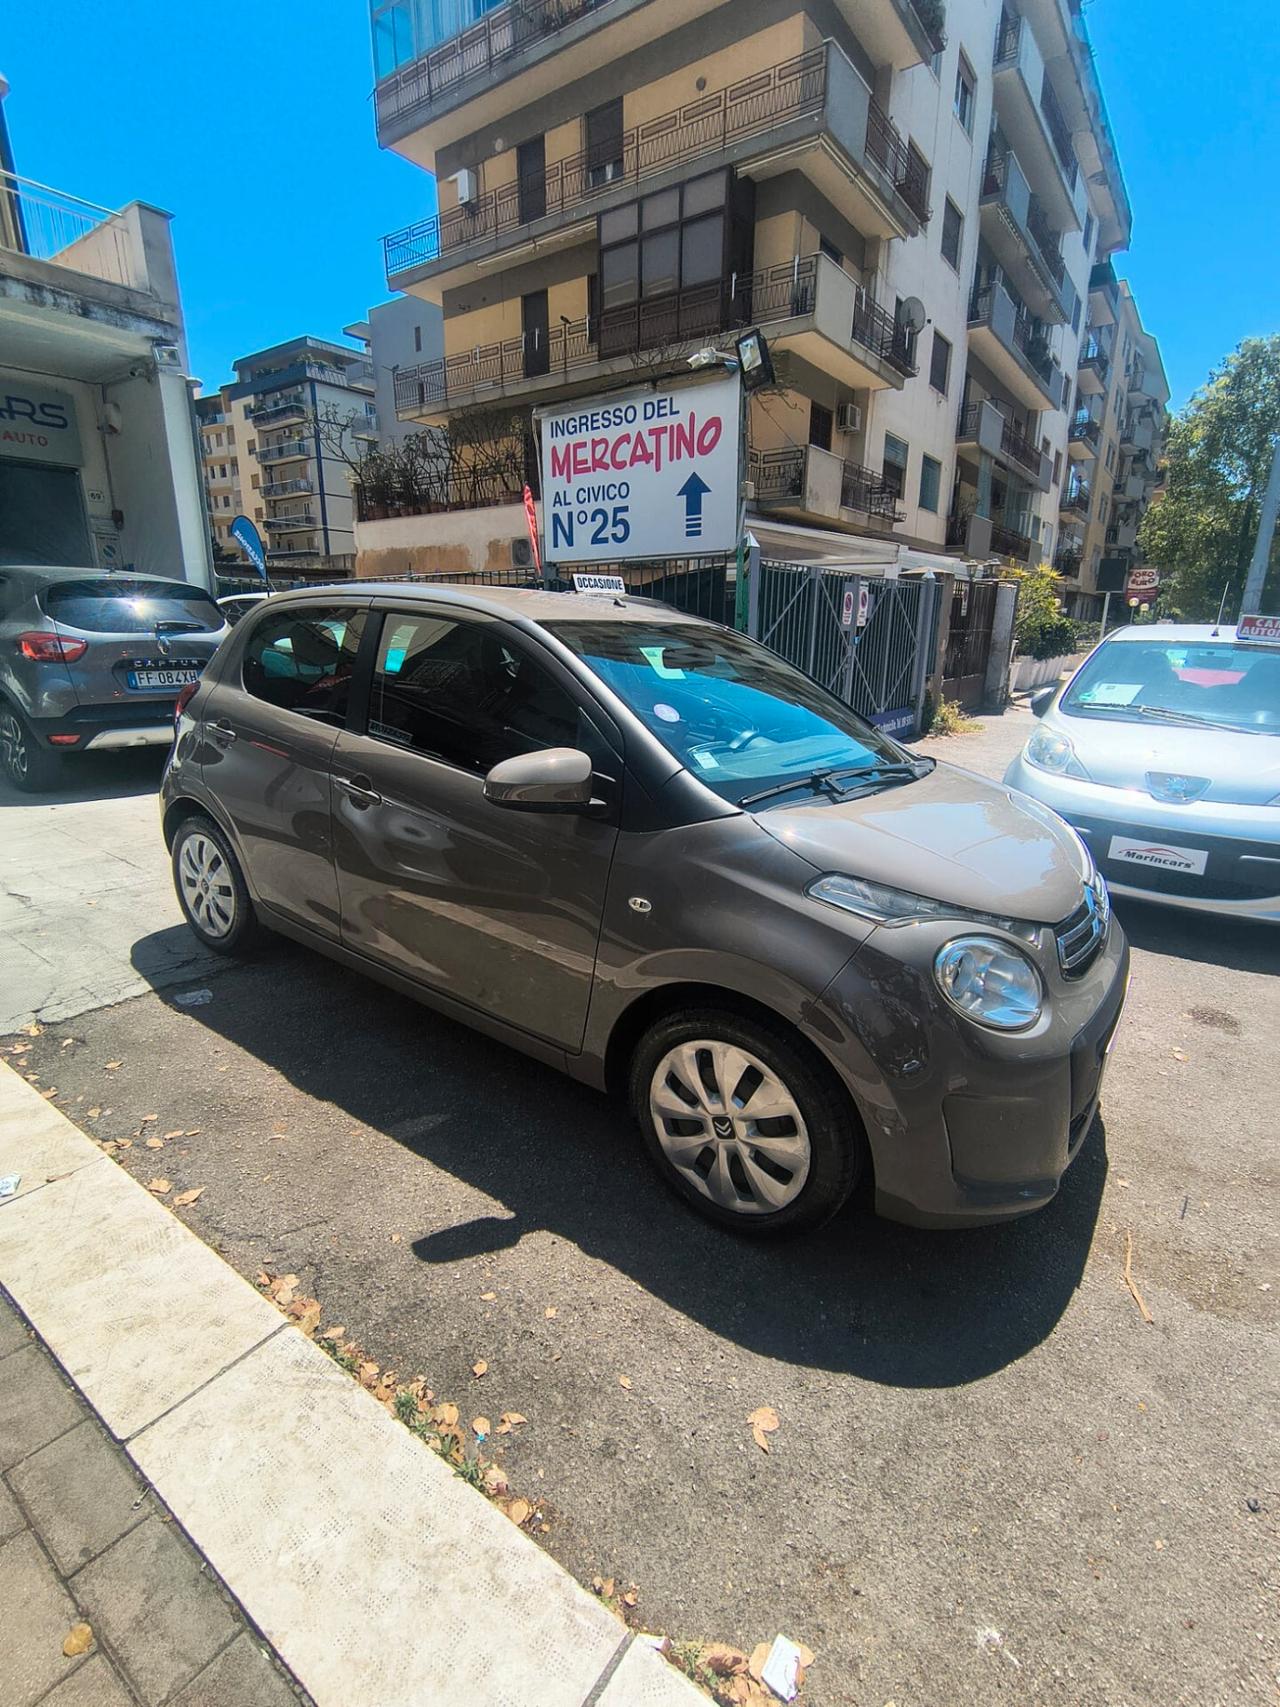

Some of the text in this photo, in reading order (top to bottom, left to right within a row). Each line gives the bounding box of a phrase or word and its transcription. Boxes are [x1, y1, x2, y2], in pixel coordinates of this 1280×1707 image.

[551, 396, 680, 439] INGRESSO DEL
[2, 430, 49, 448] AUTO
[551, 411, 722, 484] MERCATINO
[552, 481, 630, 508] AL CIVICO
[576, 577, 624, 590] OCCASIONE
[1124, 850, 1192, 869] Marincars
